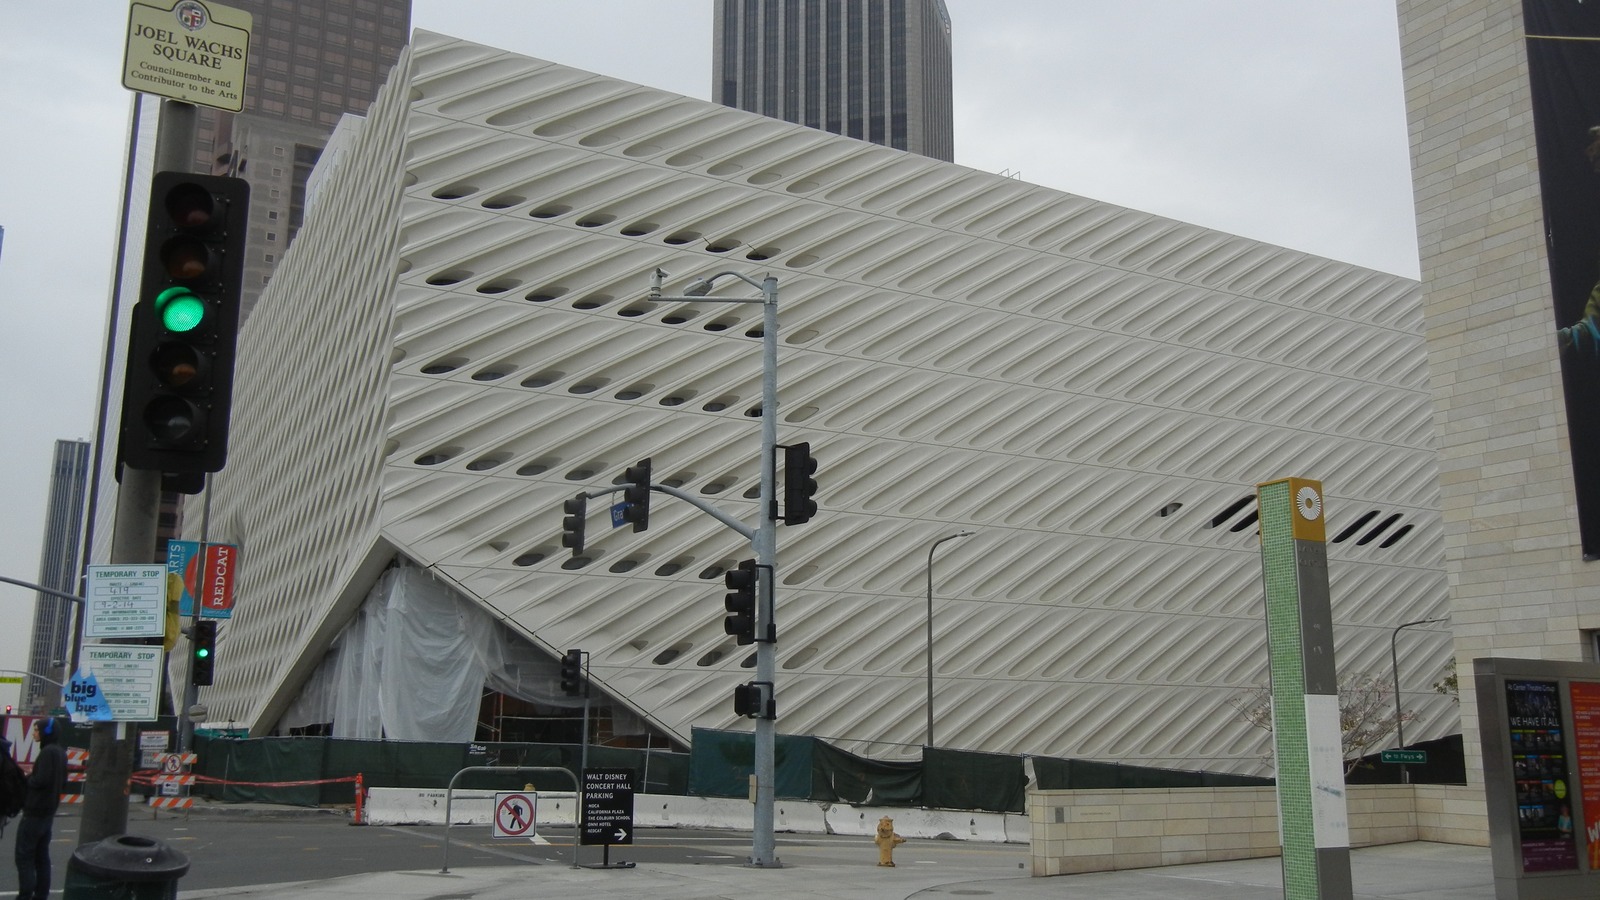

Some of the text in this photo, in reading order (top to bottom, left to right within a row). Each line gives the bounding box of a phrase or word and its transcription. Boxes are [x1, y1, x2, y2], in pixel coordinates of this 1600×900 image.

[134, 24, 242, 60] JOEL WACHS
[153, 44, 222, 69] SQUARE
[140, 61, 231, 88] Councilmember and
[131, 70, 185, 88] Contributor
[202, 86, 214, 95] the
[218, 90, 238, 100] Arts
[613, 509, 624, 521] Gra
[213, 548, 228, 606] REDCAT
[102, 601, 133, 609] 9-2-14
[71, 681, 96, 697] big
[65, 694, 86, 702] blue
[75, 702, 98, 712] bus
[1510, 717, 1559, 726] WE HAVE IT ALL
